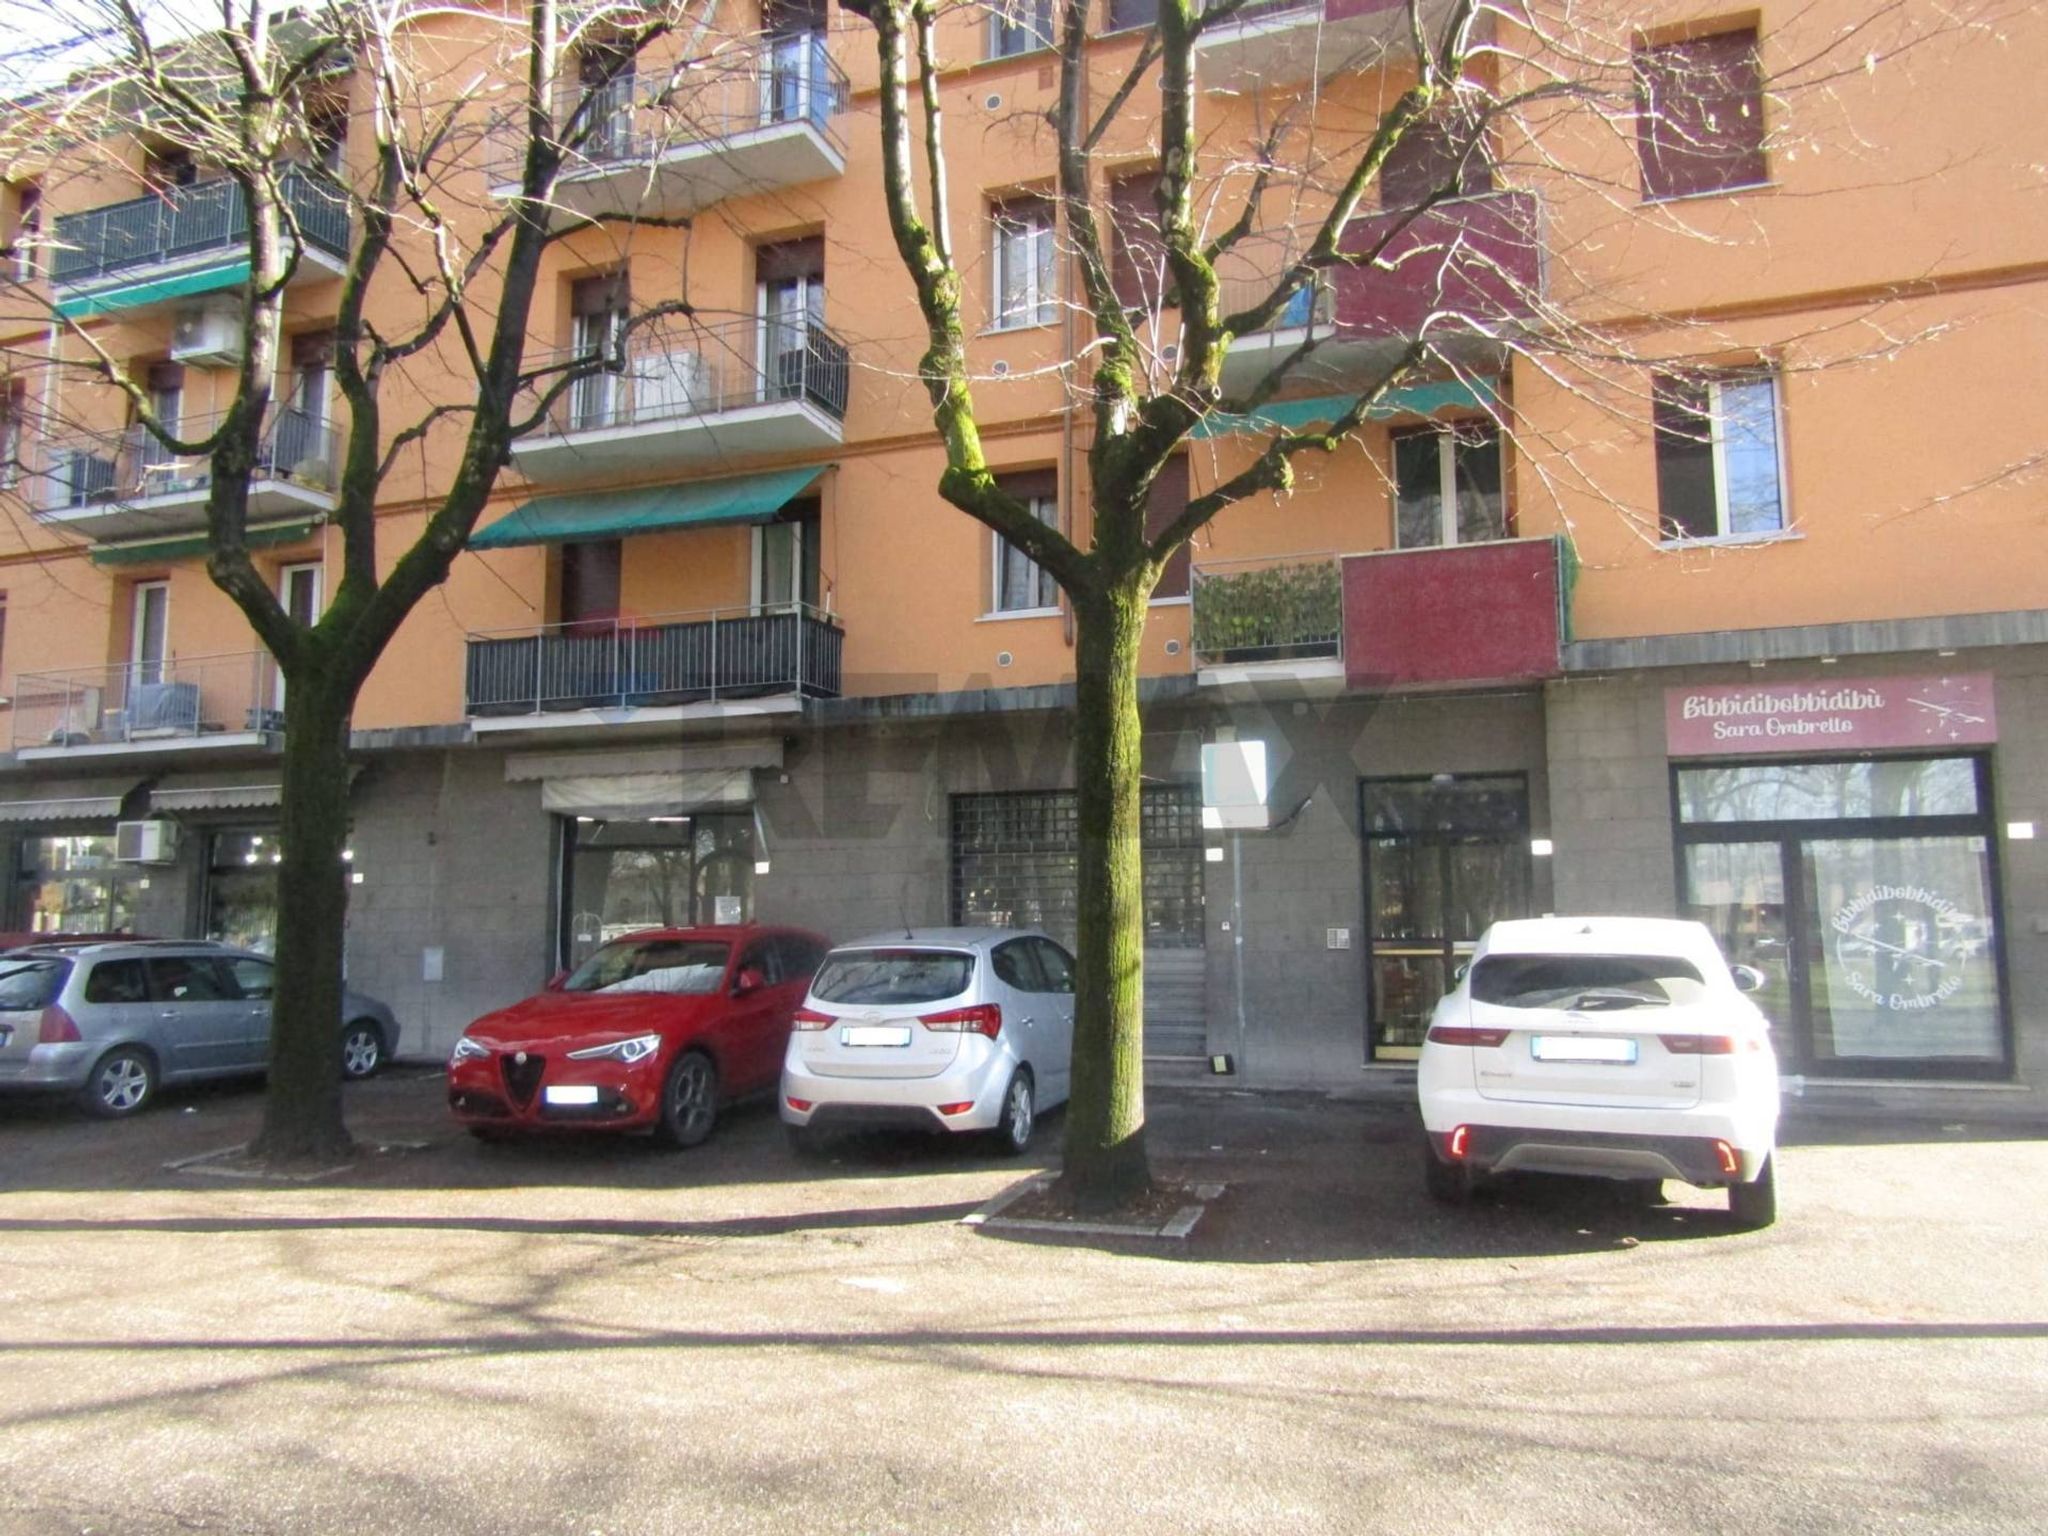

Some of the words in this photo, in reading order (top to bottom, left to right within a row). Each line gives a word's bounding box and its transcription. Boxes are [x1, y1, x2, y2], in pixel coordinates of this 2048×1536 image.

[1683, 688, 1886, 719] Bibbidibobbidibù
[1713, 720, 1764, 740] Sara
[1766, 717, 1854, 736] Ombrello
[1845, 971, 1886, 1005] Sara
